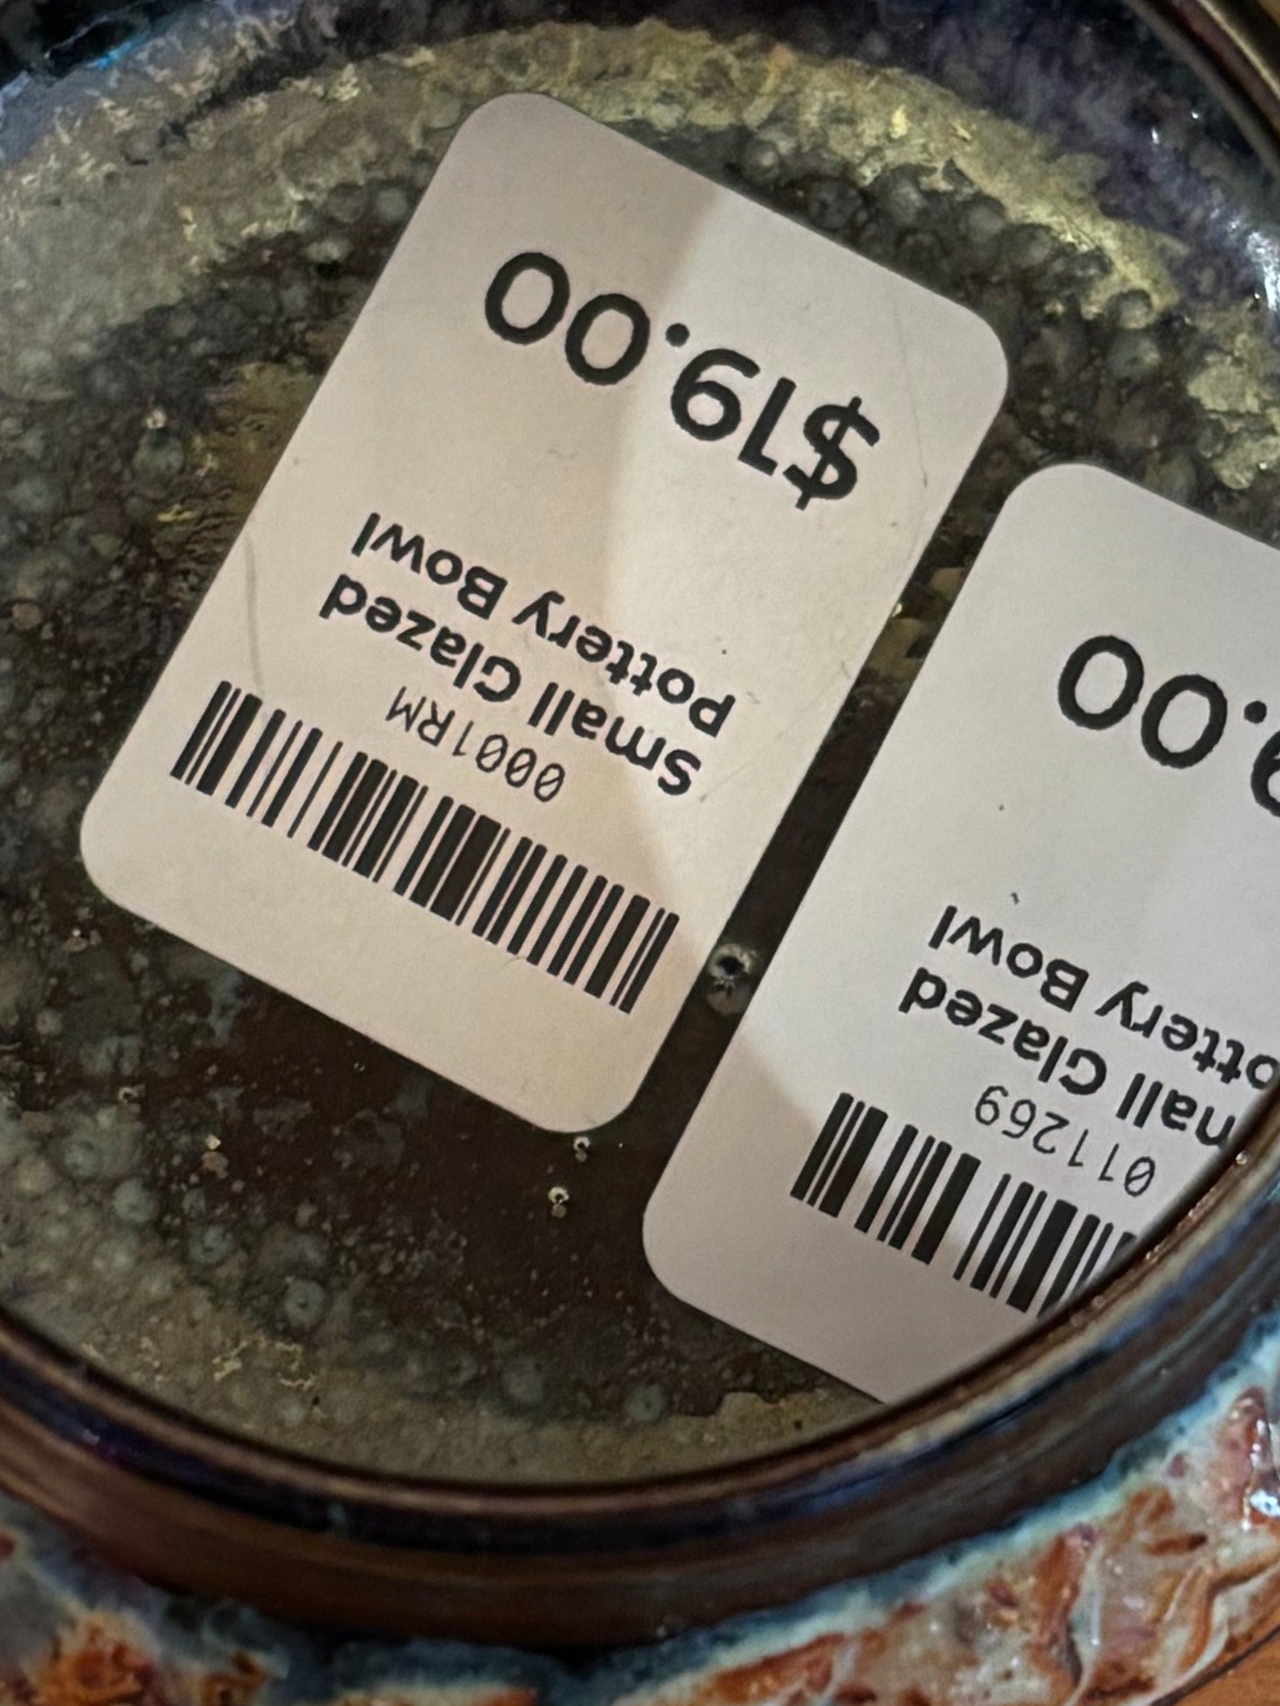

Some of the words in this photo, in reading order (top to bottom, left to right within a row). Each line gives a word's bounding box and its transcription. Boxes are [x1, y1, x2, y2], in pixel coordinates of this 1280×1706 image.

[484, 251, 880, 511] $19.00
[351, 512, 508, 620] Bowl
[318, 573, 521, 702] Glazed
[511, 590, 736, 738] Pottery
[385, 686, 566, 803] 0001RM
[527, 682, 702, 796] Small
[928, 905, 1089, 1013] Bowl
[898, 967, 1108, 1096] Glazed
[975, 1085, 1156, 1197] 011269
[1115, 1073, 1236, 1149] mall
